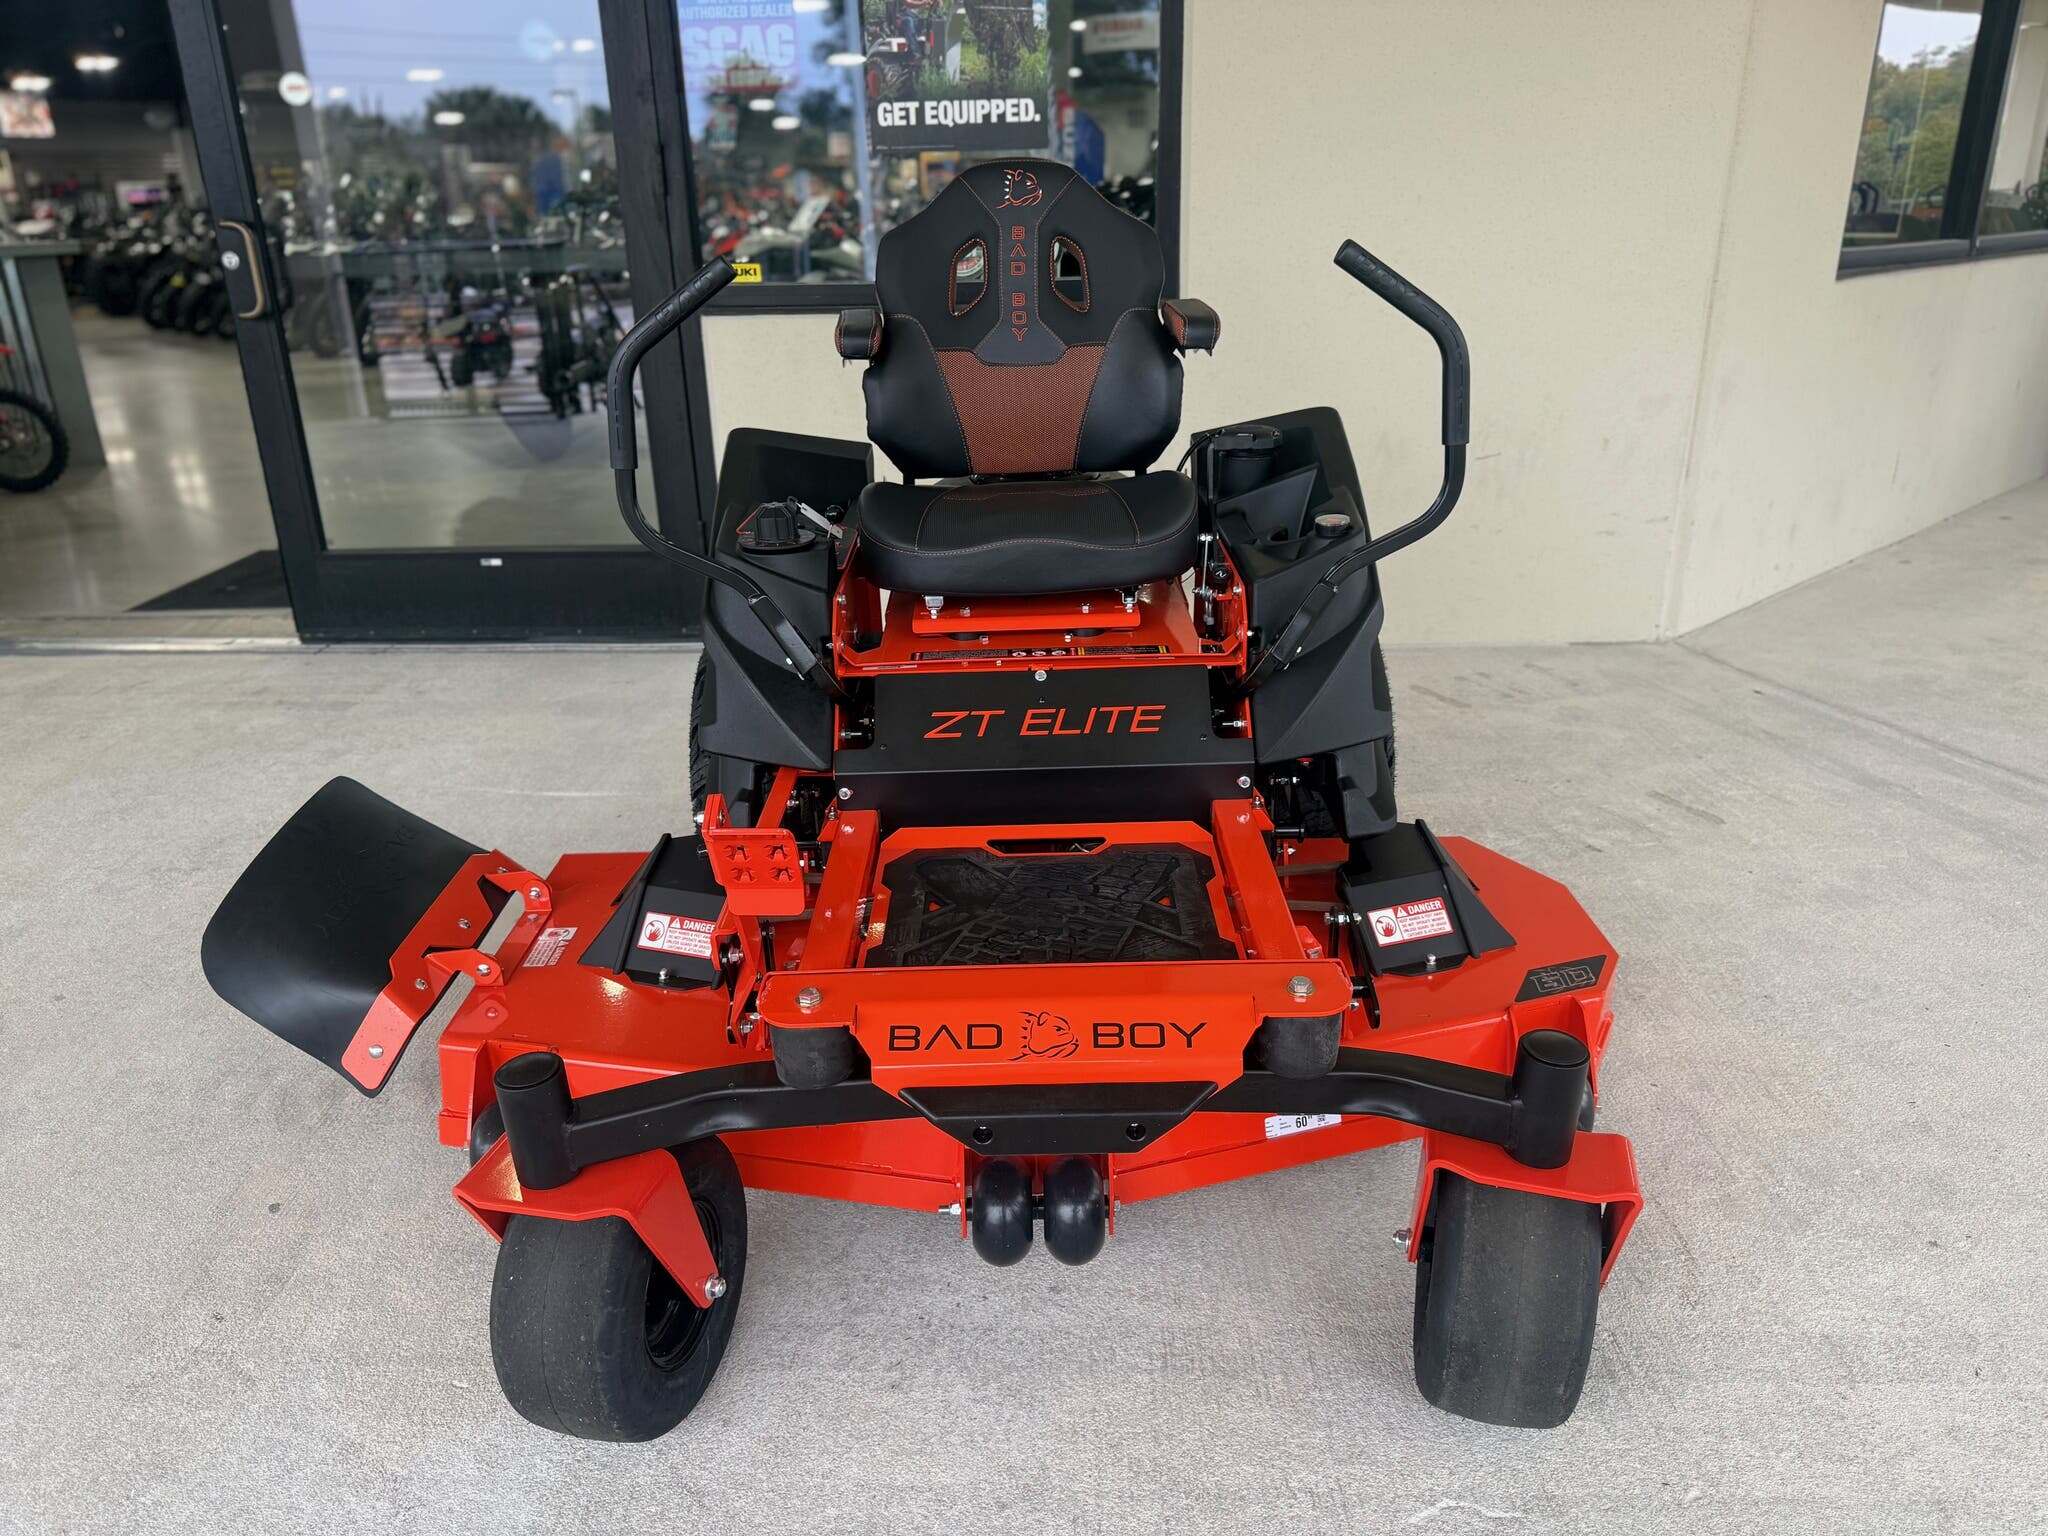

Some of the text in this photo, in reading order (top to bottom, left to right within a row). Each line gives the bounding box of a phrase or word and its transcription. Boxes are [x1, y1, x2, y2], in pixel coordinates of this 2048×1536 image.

[680, 3, 793, 19] AUTHORIZED DEALER
[877, 98, 1041, 127] GET EQUIPPED.
[1010, 226, 1027, 276] BAD
[1011, 292, 1028, 341] BOY
[923, 704, 1167, 739] ZT ELITE
[1408, 900, 1442, 915] DANGER
[888, 1022, 1208, 1052] BAD BOY
